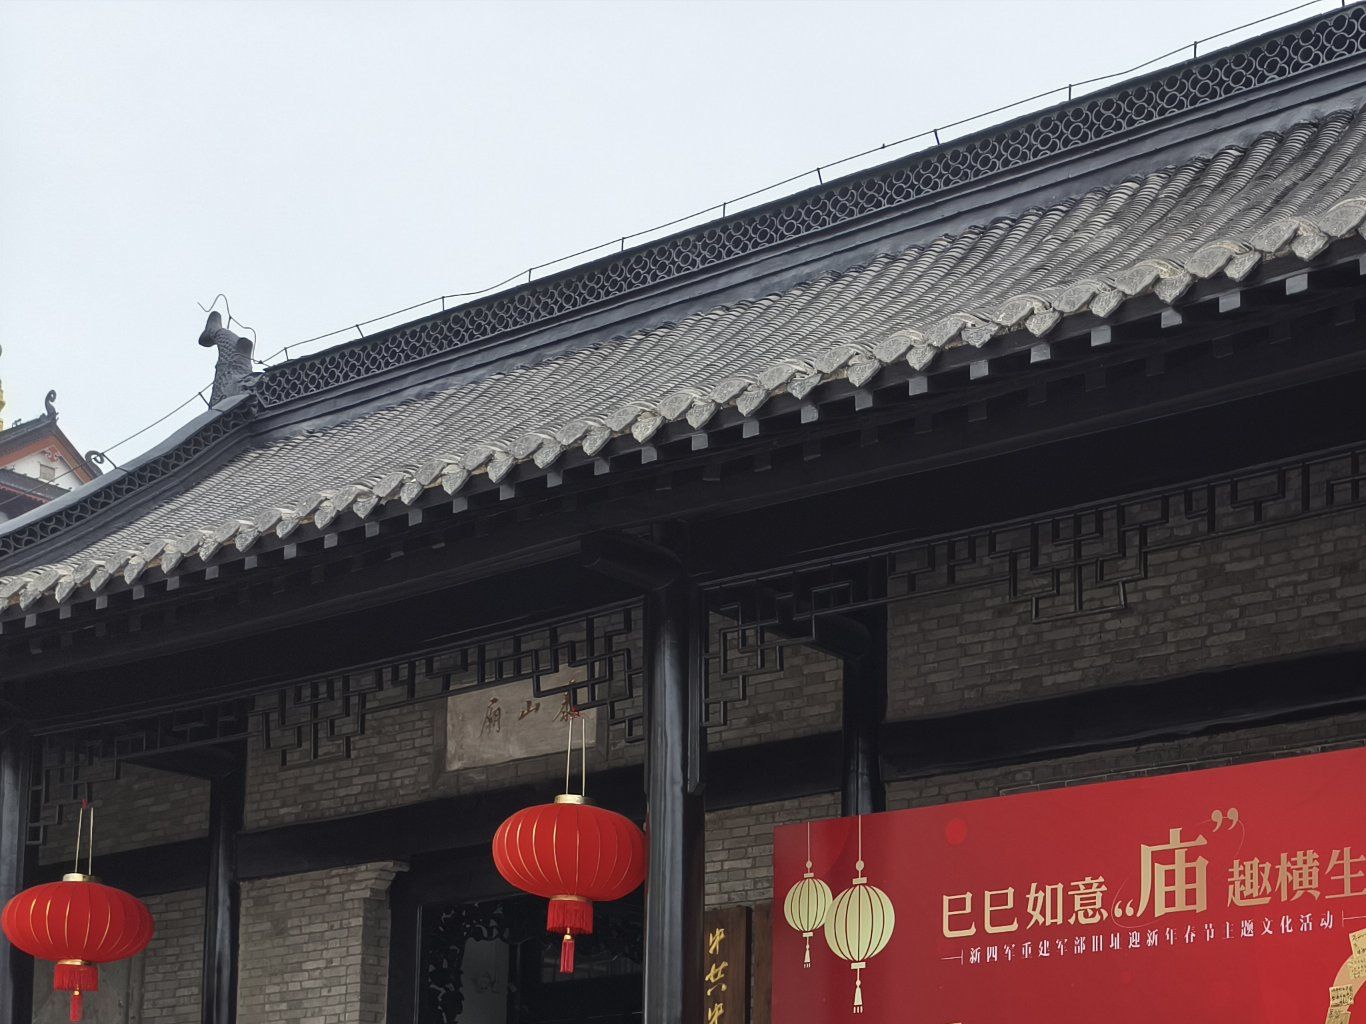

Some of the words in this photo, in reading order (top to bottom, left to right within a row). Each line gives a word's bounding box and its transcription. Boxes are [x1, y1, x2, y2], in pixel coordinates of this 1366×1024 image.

[968, 910, 1334, 964] 新四军重建军部旧址迎新年春节主题文化活动
